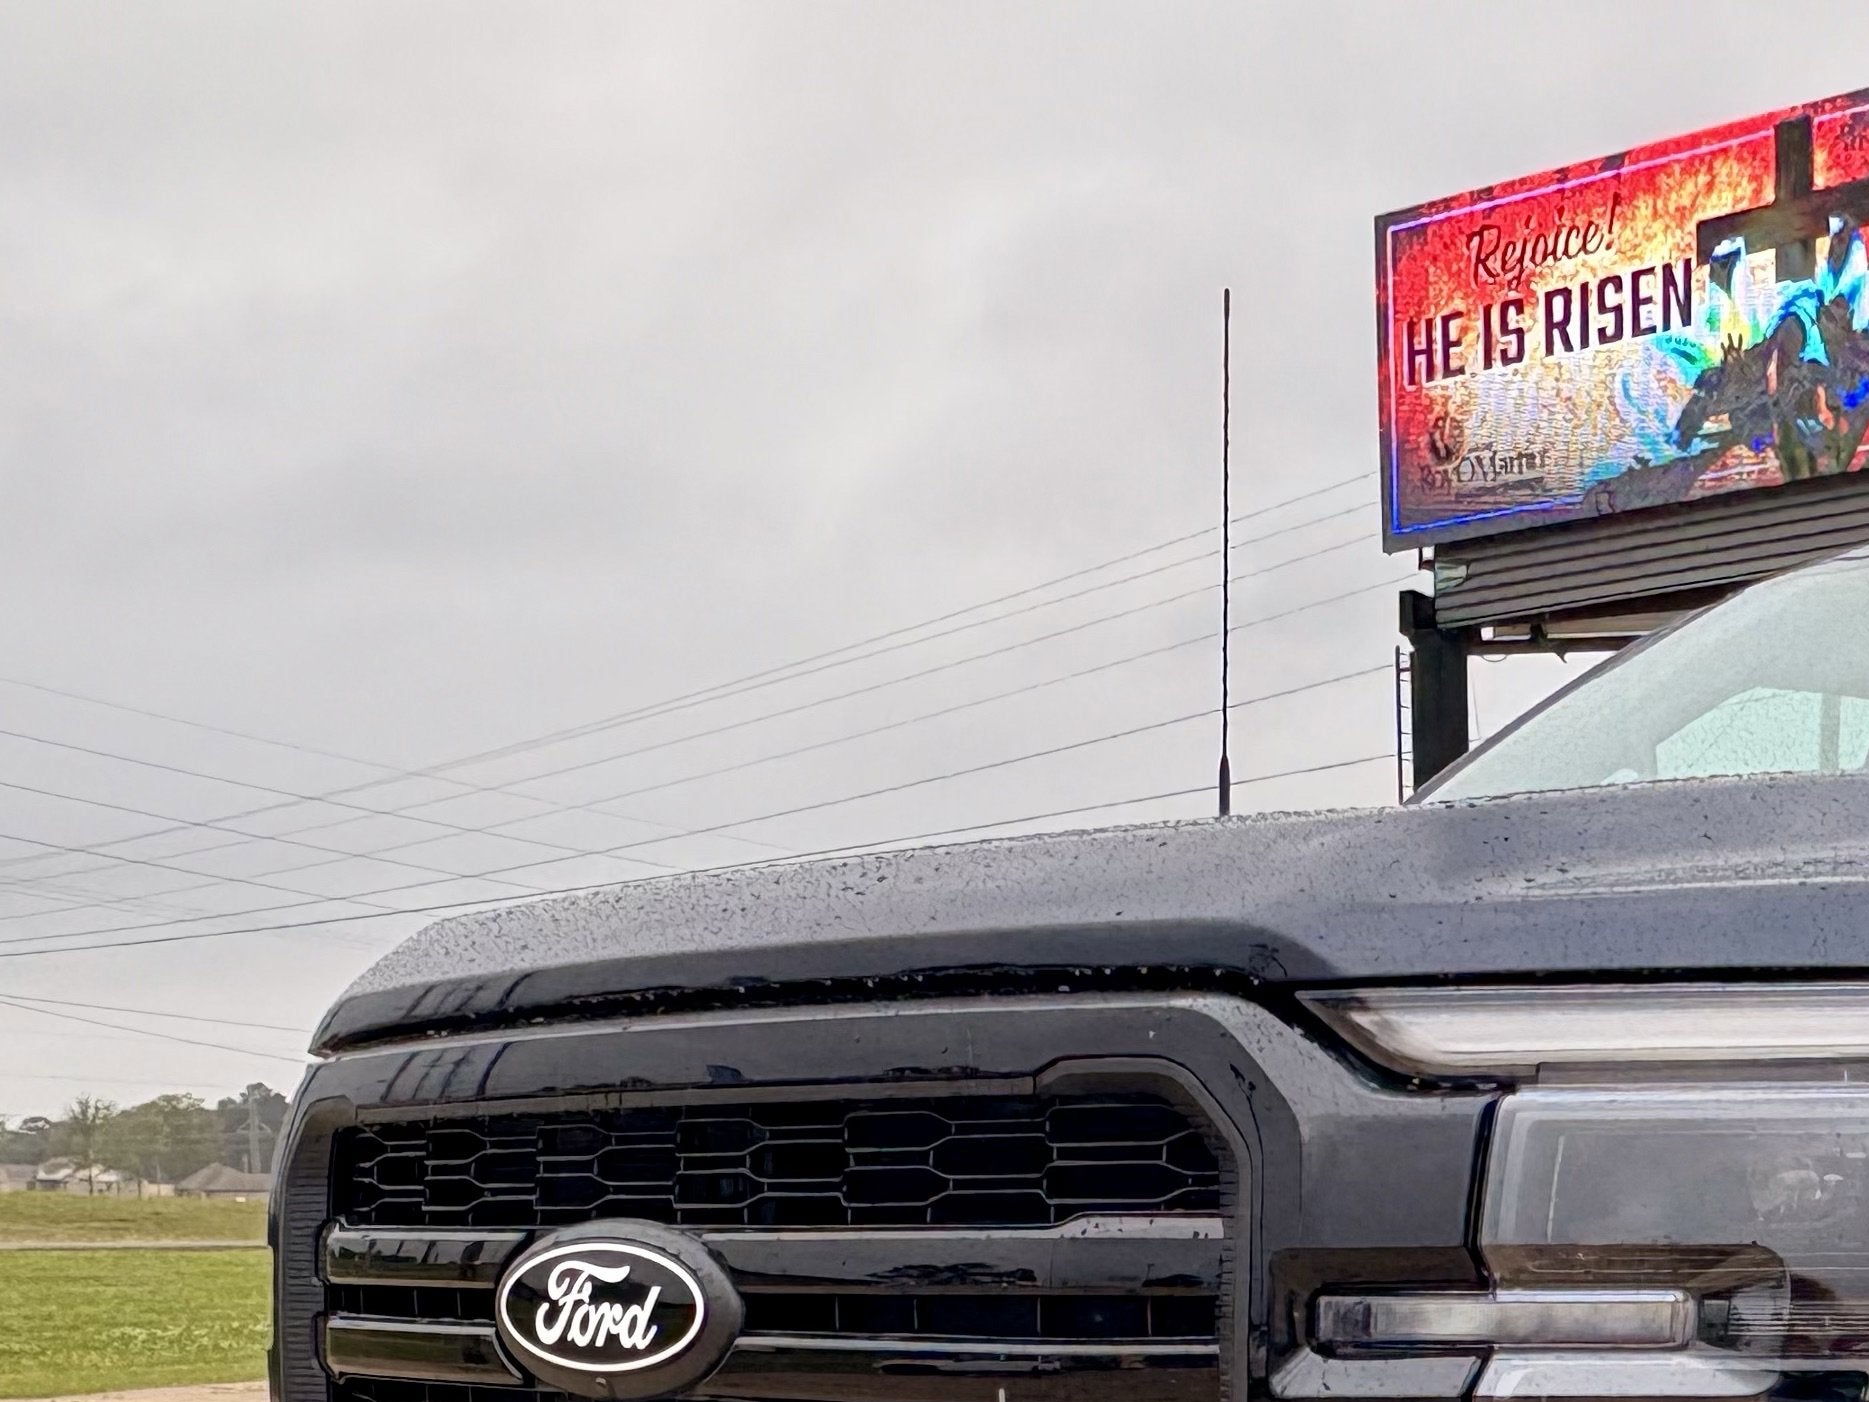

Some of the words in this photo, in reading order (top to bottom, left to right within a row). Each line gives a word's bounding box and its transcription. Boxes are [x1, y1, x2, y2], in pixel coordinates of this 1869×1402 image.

[1466, 192, 1621, 290] Rejoice!
[1406, 311, 1466, 386] HE
[1482, 299, 1526, 370] IS
[1545, 258, 1693, 357] RISEN
[535, 1260, 662, 1350] Ford
